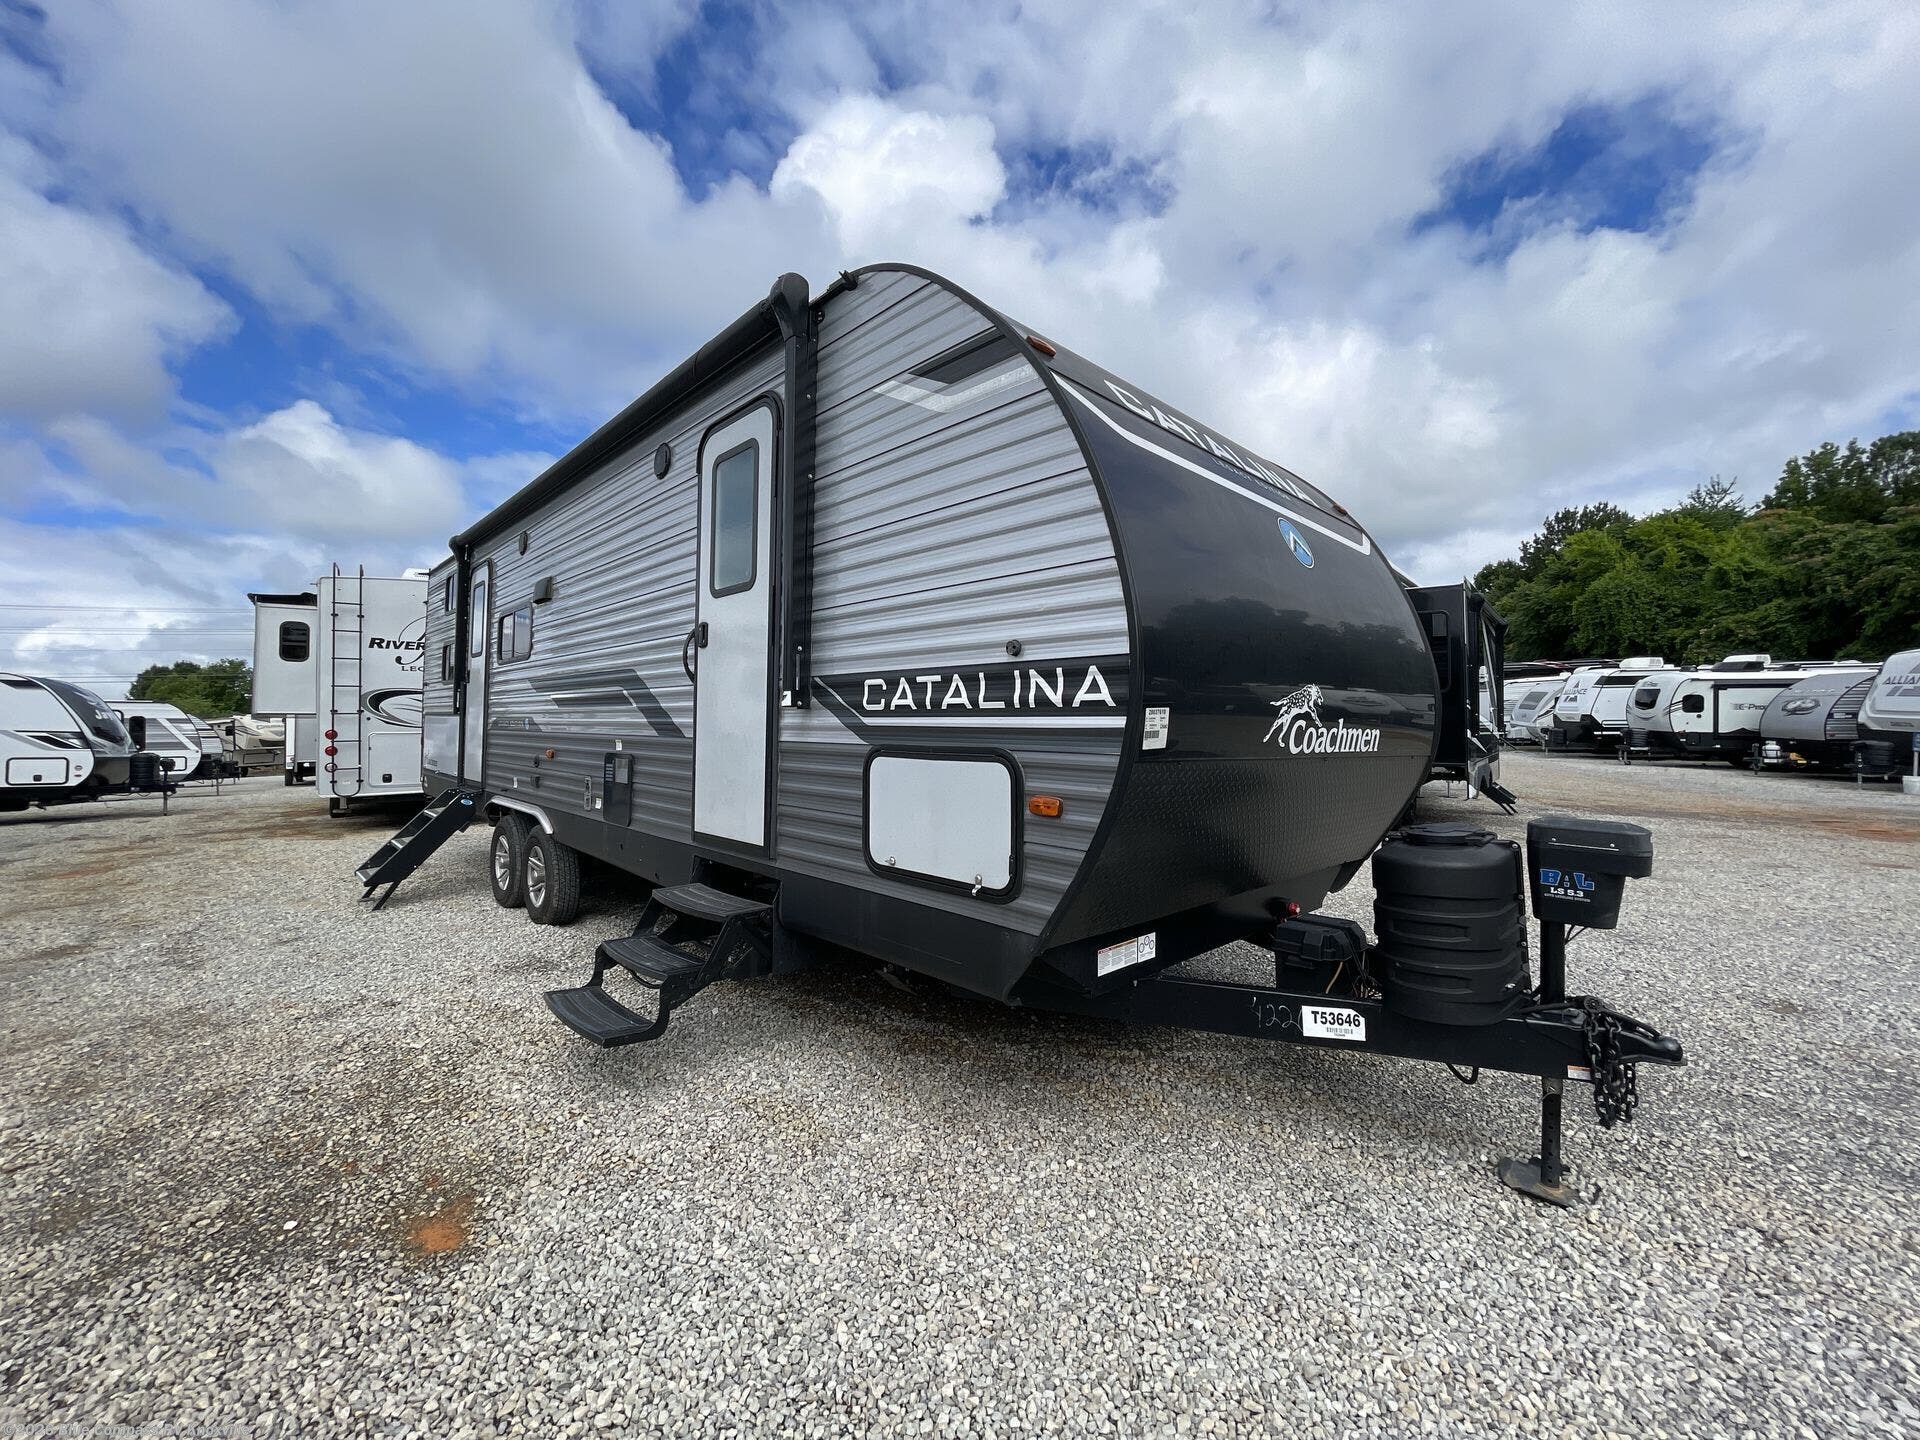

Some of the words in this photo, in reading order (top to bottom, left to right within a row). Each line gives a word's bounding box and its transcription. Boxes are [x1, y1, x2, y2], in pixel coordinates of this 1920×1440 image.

[1103, 379, 1320, 508] CATALINA
[862, 664, 1117, 711] CATALINA
[1289, 718, 1380, 755] Coachmen
[1539, 868, 1595, 891] BAL
[1550, 886, 1565, 895] LS
[1310, 1010, 1361, 1029] T53646
